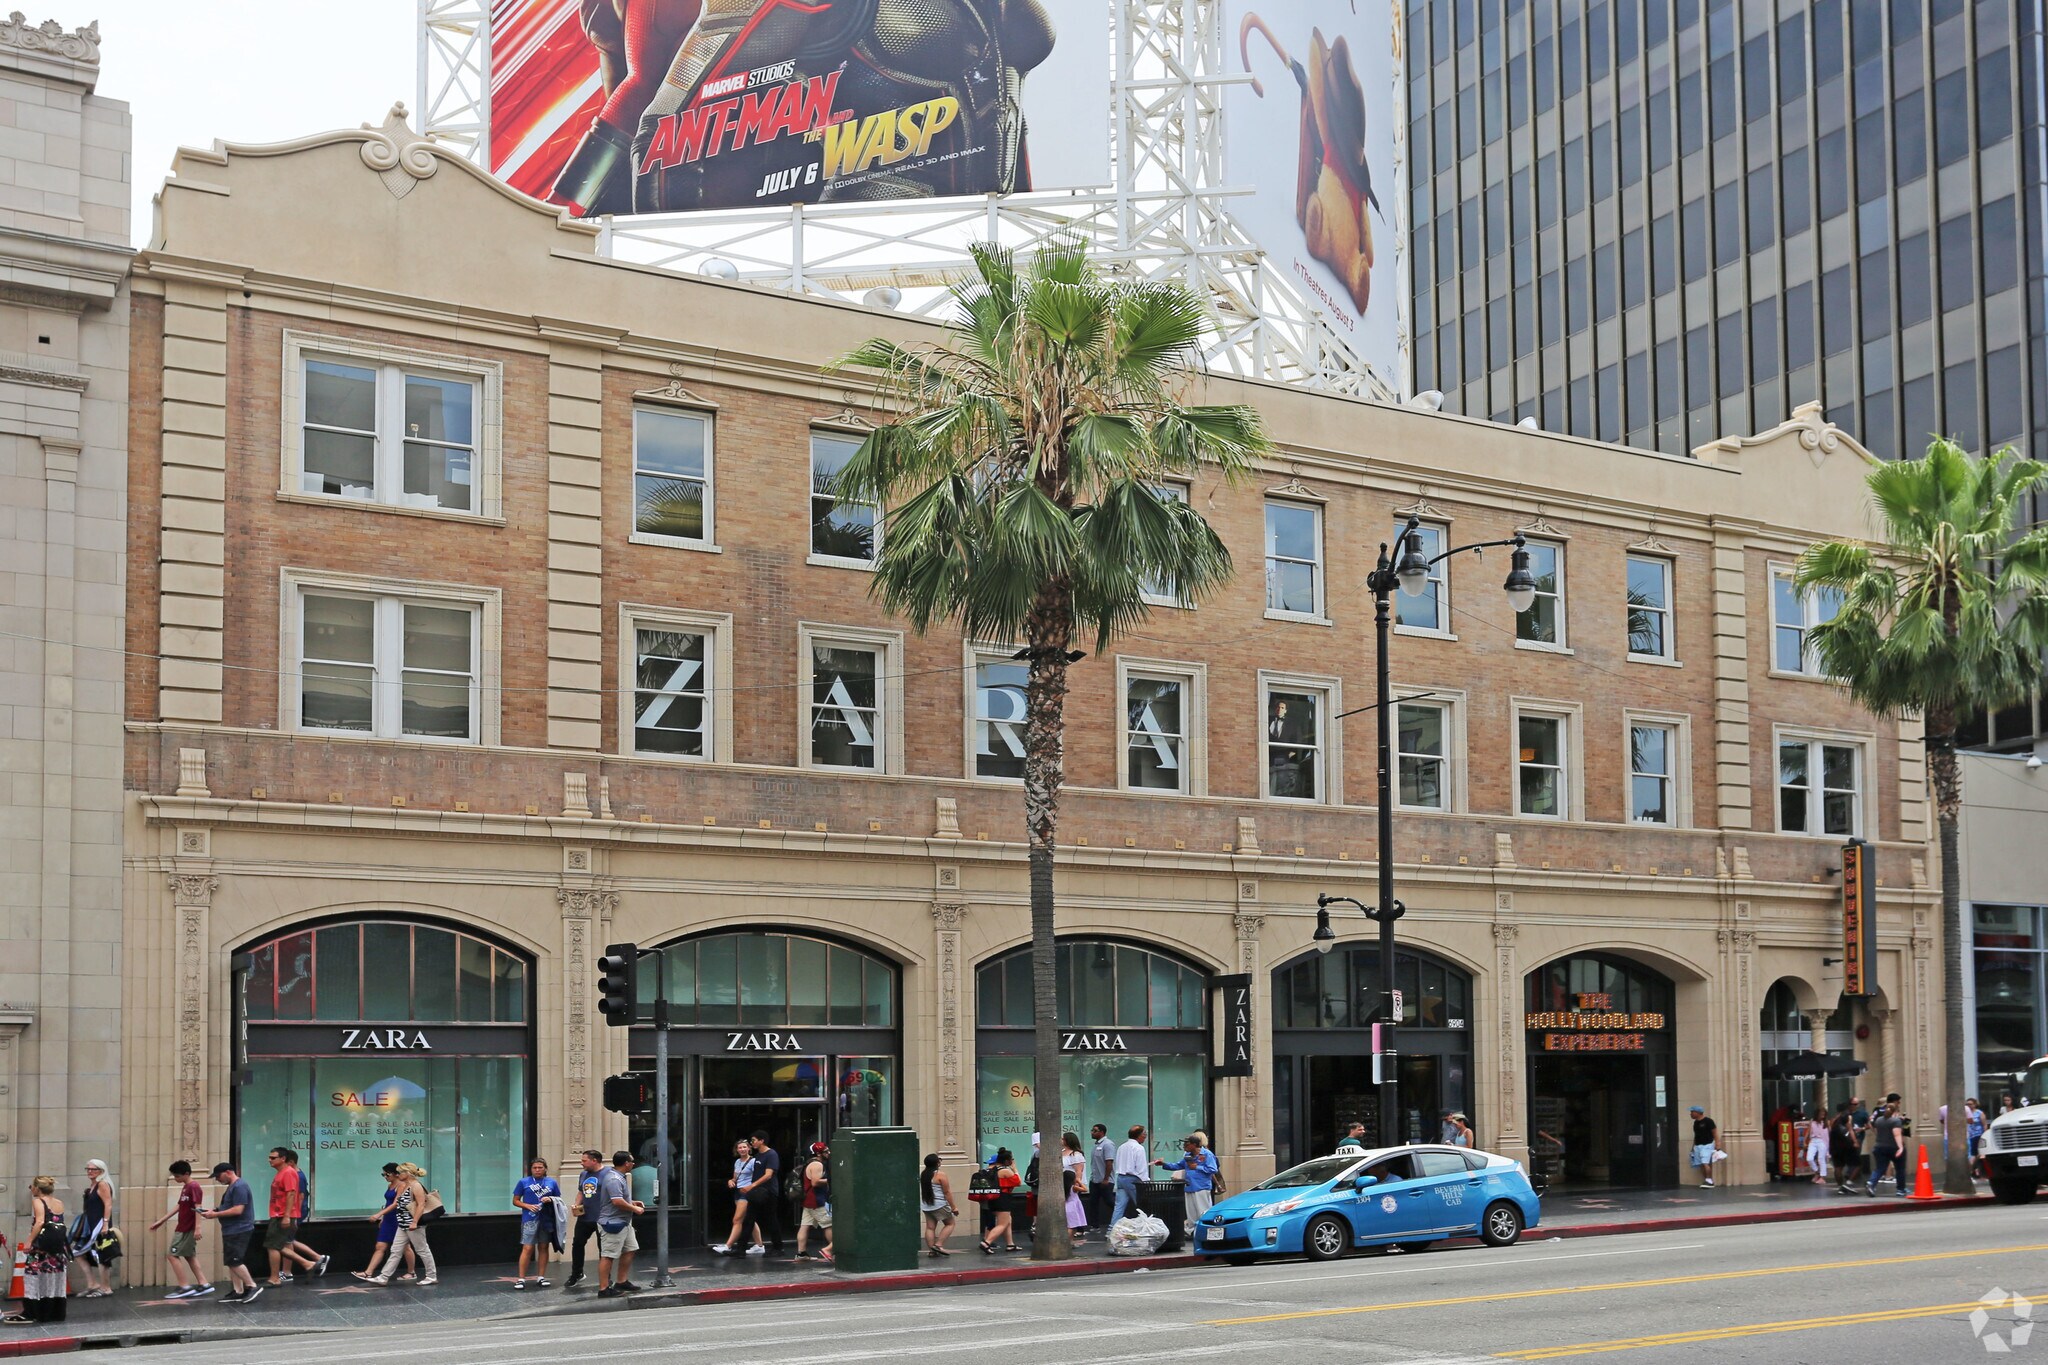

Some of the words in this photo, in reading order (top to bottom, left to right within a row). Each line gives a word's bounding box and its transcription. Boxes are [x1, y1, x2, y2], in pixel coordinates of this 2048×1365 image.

[701, 74, 745, 99] MARVEL
[748, 61, 795, 86] STUDIOS
[637, 70, 844, 176] ANT-MAN
[802, 128, 823, 144] THE
[823, 96, 960, 181] WASP
[845, 176, 866, 186] DOLBY
[940, 153, 959, 162] AND
[960, 145, 986, 156] IMAX
[756, 166, 802, 197] JULY
[804, 163, 819, 185] 6
[1293, 257, 1300, 274] In
[1301, 265, 1327, 304] Theatres
[1328, 297, 1349, 327] August
[1350, 319, 1354, 332] 3
[1578, 993, 1612, 1009] THE
[1236, 989, 1247, 1061] ZARA
[1527, 1012, 1665, 1029] HOLLYWOODLAND
[341, 1029, 432, 1049] ZARA
[727, 1033, 802, 1050] ZARA
[1062, 1033, 1127, 1050] ZARA
[1547, 1033, 1645, 1050] EXPERIENCE
[331, 1092, 389, 1106] SALE
[1011, 1085, 1032, 1097] SA
[1063, 1124, 1079, 1132] SAL
[292, 1141, 310, 1150] ALE
[321, 1141, 355, 1149] SALE
[361, 1140, 395, 1148] SALE
[401, 1139, 424, 1148] SAL
[1153, 1141, 1182, 1151] ZAR
[1781, 1123, 1790, 1173] TOURS
[1434, 1184, 1466, 1194] BEVERLY
[1442, 1192, 1463, 1200] HILLS
[1356, 1196, 1371, 1204] 3304
